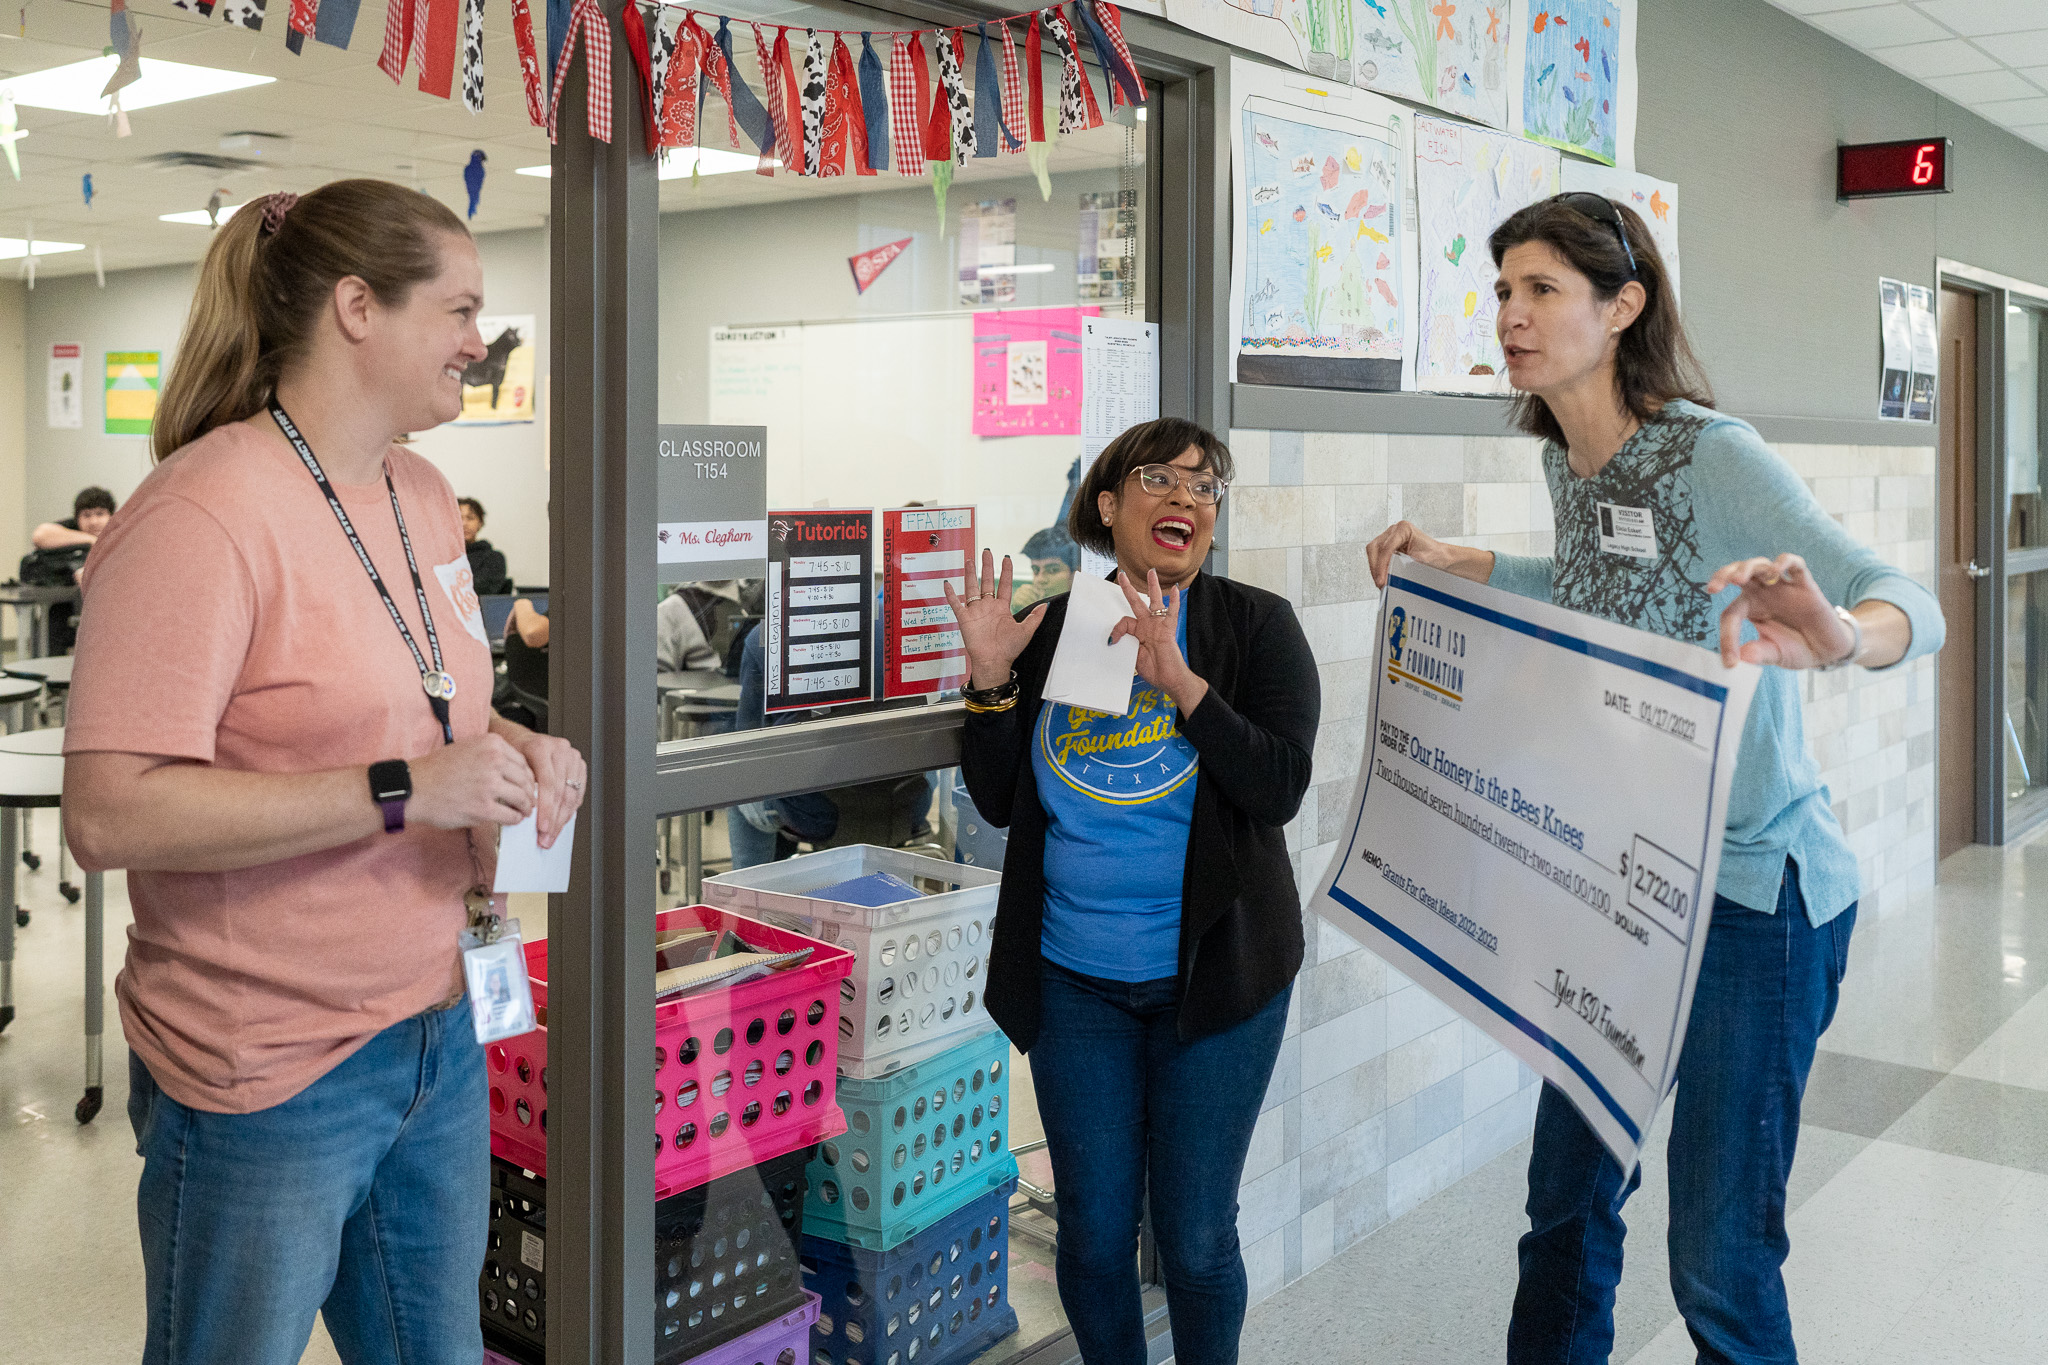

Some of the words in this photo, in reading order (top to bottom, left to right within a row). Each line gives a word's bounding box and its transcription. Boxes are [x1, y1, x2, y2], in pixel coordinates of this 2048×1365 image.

[1912, 145, 1936, 185] 6
[272, 409, 299, 439] STAFF
[292, 439, 326, 482] LEGACY
[659, 440, 761, 457] CLASSROOM
[694, 463, 728, 479] T154
[679, 531, 701, 544] Ms.
[704, 528, 754, 547] Cleghorn
[795, 519, 868, 541] Tutorials
[350, 536, 379, 580] LEGACY
[884, 528, 892, 604] Schedule
[1410, 615, 1442, 649] TYLER
[1447, 630, 1466, 658] ISD
[1406, 648, 1465, 694] FOUNDATION
[1380, 719, 1391, 735] PAY
[1391, 725, 1399, 739] TO
[1399, 729, 1410, 745] THE
[1604, 689, 1632, 715] DATE:
[1640, 700, 1697, 741] 01/17/2023
[1055, 715, 1183, 766] Foundati
[1380, 732, 1398, 752] ORDER
[1397, 742, 1408, 757] OF:
[1410, 736, 1433, 767] Our
[1433, 747, 1473, 792] Honey
[1474, 768, 1486, 795] is
[1487, 777, 1509, 808] the
[1510, 787, 1541, 826] Bees
[1542, 804, 1585, 851] Knees
[1375, 758, 1394, 783] Two
[1393, 768, 1430, 806] thousand
[1429, 794, 1454, 818] seven
[1454, 803, 1494, 842] hundred
[1494, 827, 1552, 877] twenty-two
[1552, 867, 1573, 889] and
[1573, 874, 1612, 914] 00/100
[1361, 848, 1383, 871] MEMO:
[1382, 863, 1406, 889] Grants
[1405, 877, 1419, 898] For
[1419, 886, 1440, 912] Great
[1439, 899, 1458, 925] Ideas
[1458, 913, 1499, 951] 2022-2023
[1619, 849, 1630, 880] $
[1635, 864, 1689, 919] 2,722.00
[1614, 910, 1650, 946] DOLLARS
[1554, 968, 1577, 1008] Tyler
[1576, 986, 1600, 1026] ISD
[1599, 1003, 1646, 1071] Foundation
